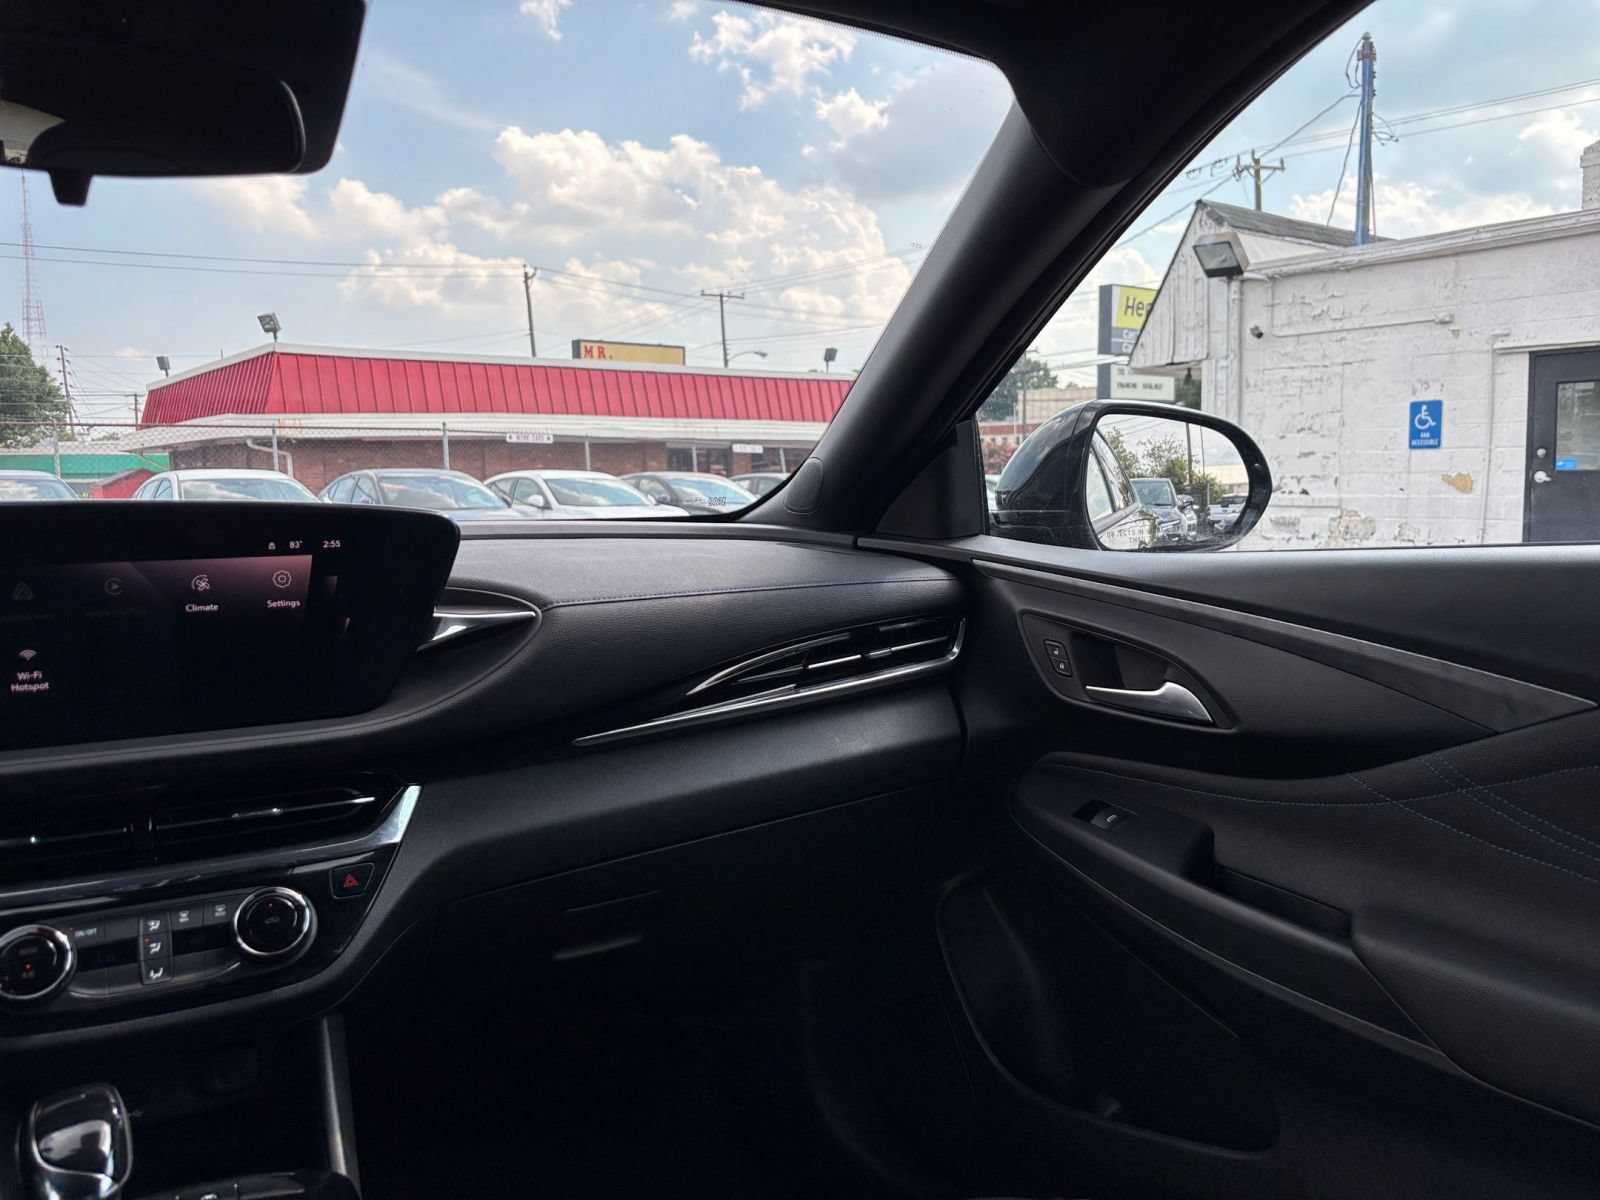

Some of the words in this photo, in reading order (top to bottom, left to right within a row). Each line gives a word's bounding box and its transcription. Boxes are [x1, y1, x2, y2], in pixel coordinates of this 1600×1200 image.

[583, 345, 613, 360] MR.
[323, 539, 341, 549] 2:55
[185, 603, 219, 613] Climate
[267, 599, 301, 609] Settings
[16, 670, 43, 681] Wi-Fi
[10, 681, 50, 693] Hotspot
